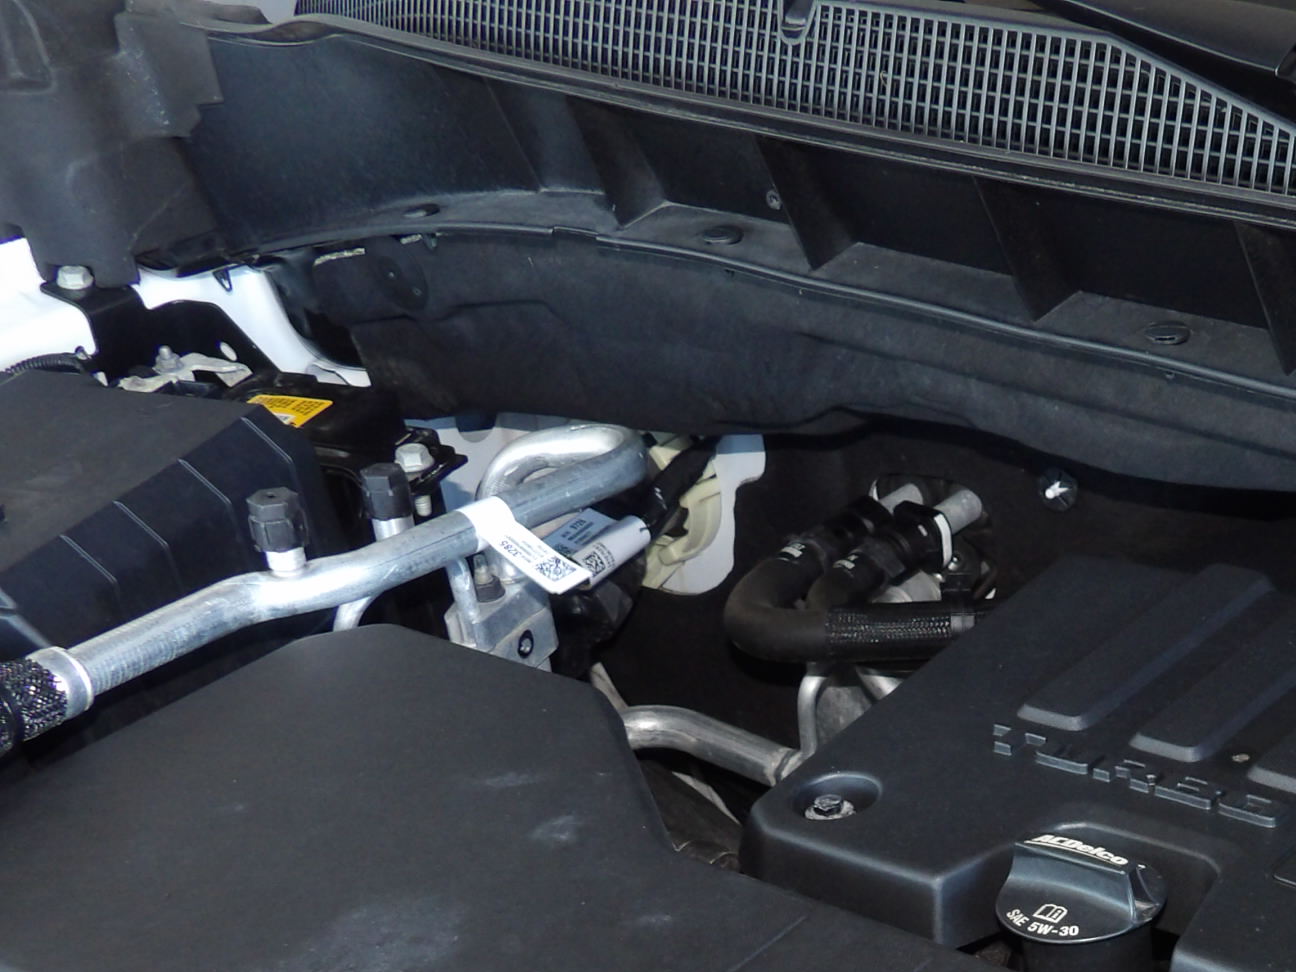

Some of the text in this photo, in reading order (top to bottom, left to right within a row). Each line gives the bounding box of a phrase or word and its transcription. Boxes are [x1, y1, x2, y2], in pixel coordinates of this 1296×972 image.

[1030, 833, 1129, 866] ACDelco
[1006, 909, 1080, 937] SAE 5W-30
